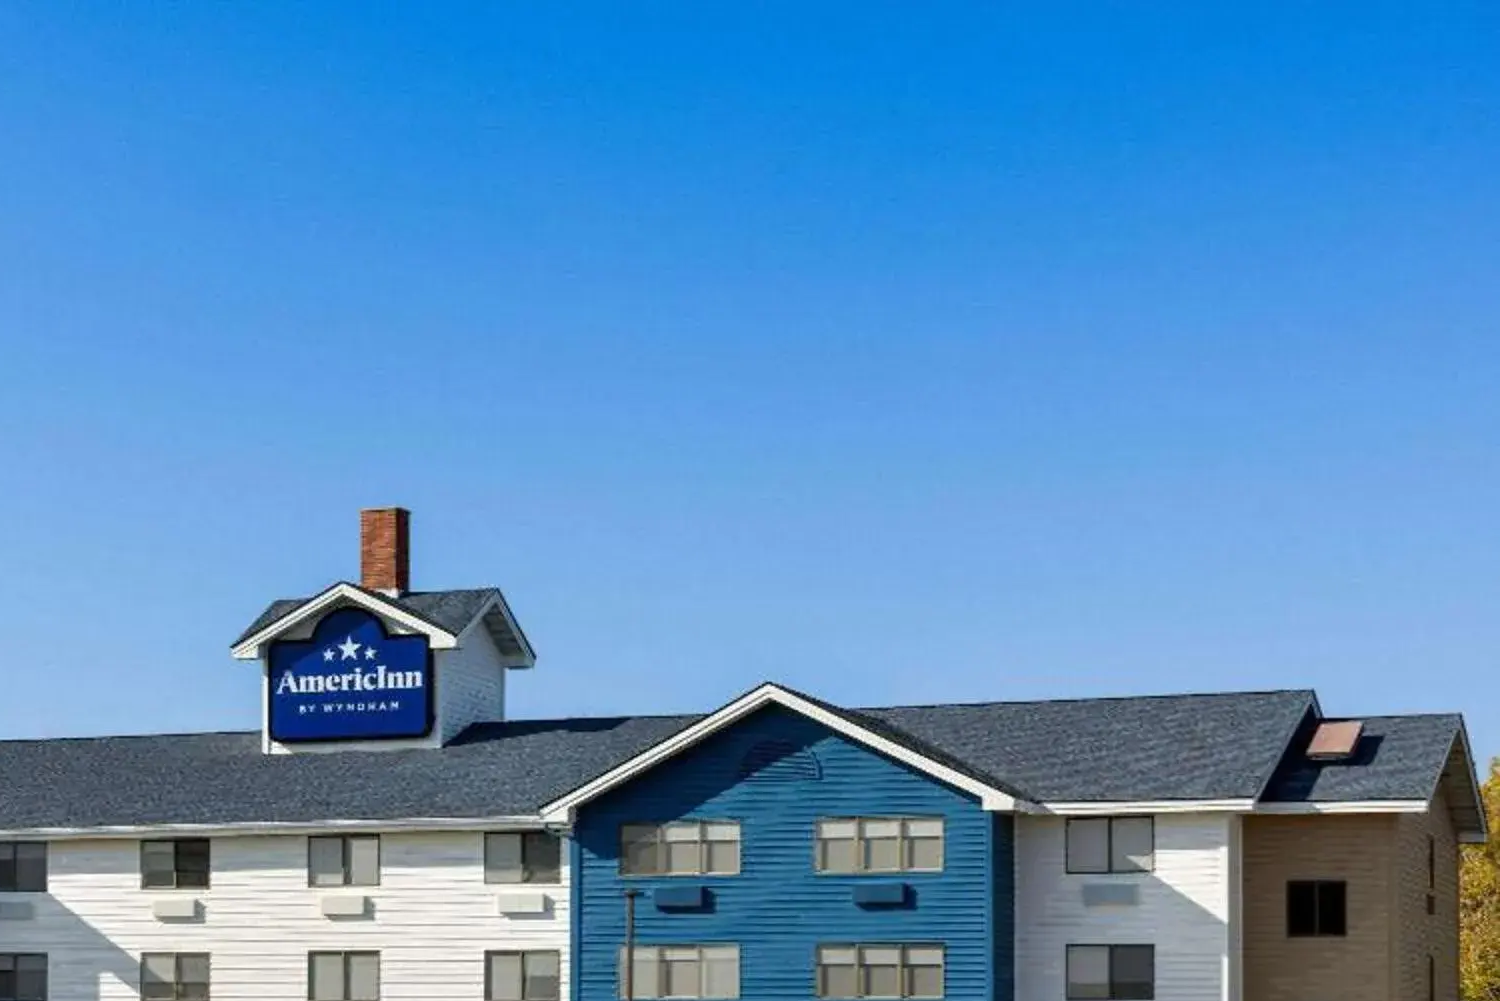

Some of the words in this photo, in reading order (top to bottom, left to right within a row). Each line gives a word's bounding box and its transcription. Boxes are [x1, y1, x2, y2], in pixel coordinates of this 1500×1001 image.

[276, 665, 422, 694] AmericInn
[298, 704, 316, 715] BY
[323, 701, 399, 713] WYNDHAM
